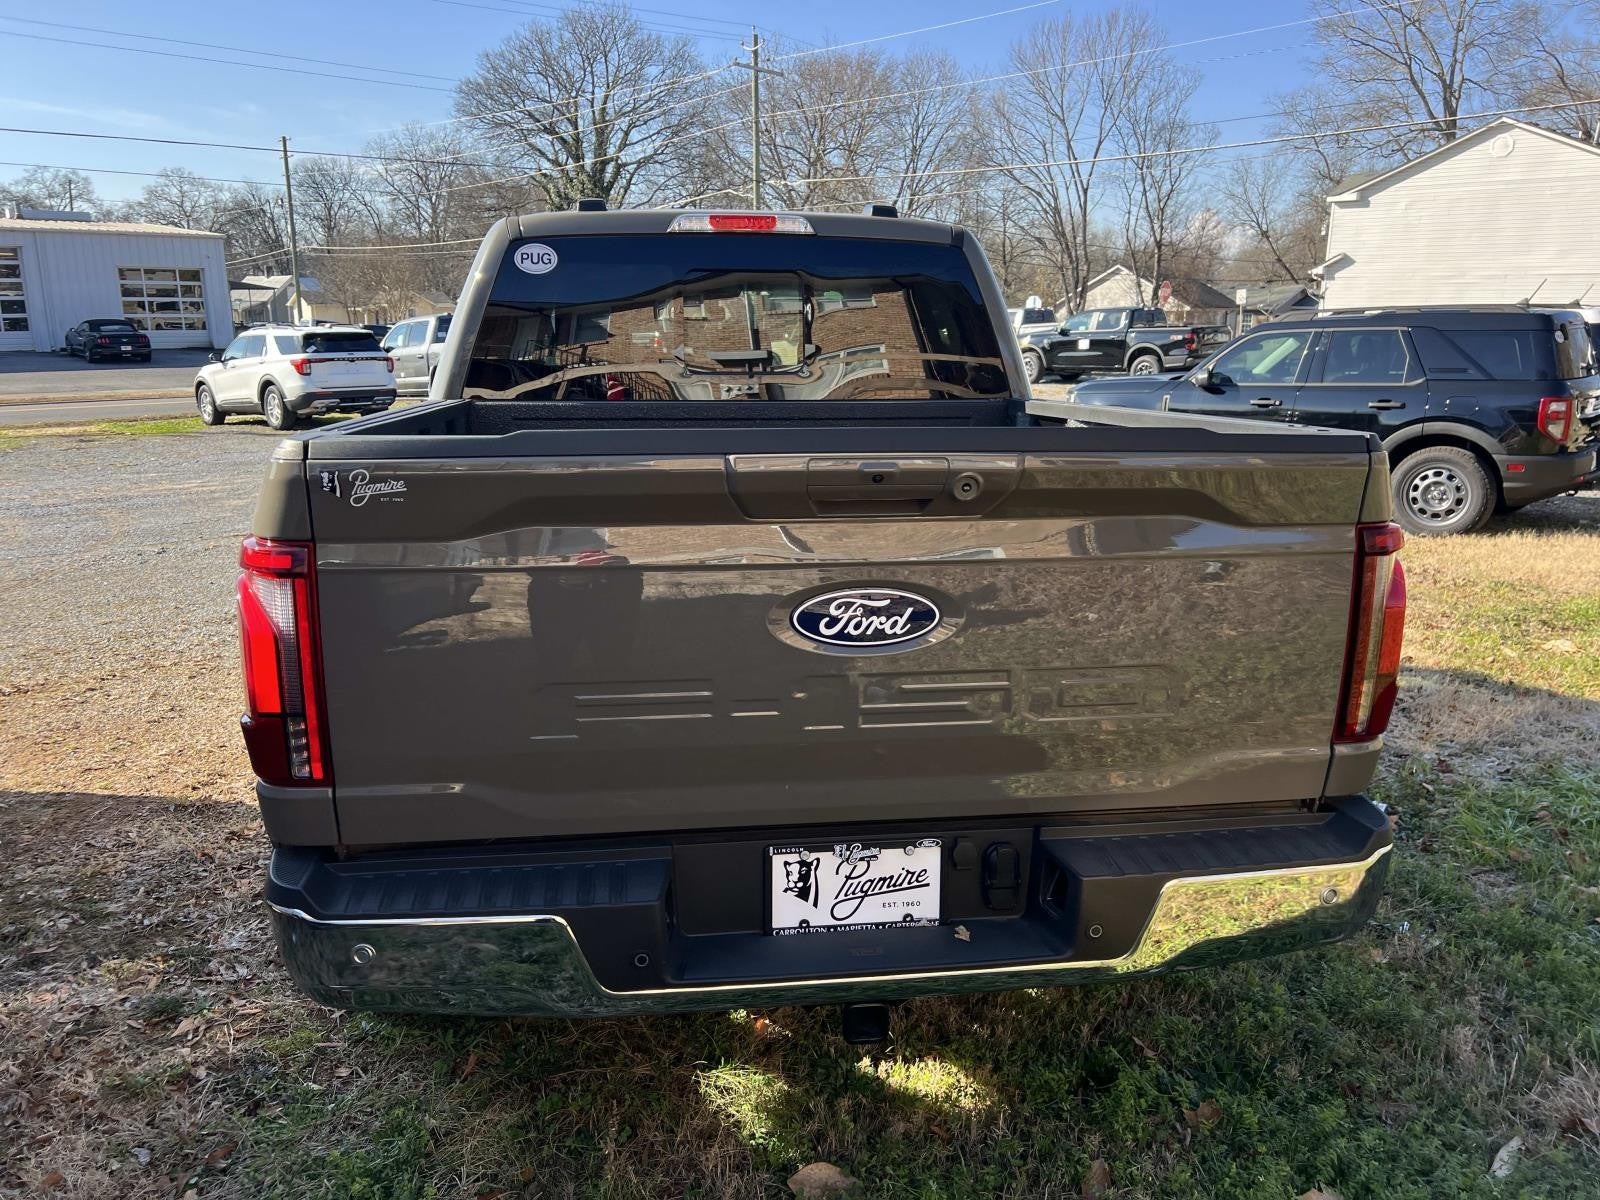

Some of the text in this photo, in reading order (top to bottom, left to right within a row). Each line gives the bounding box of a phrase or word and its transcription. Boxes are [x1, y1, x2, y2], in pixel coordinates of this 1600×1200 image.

[520, 252, 552, 265] PUG
[349, 469, 408, 507] Pugmire
[819, 598, 914, 636] Ford
[830, 859, 931, 921] Pugmire
